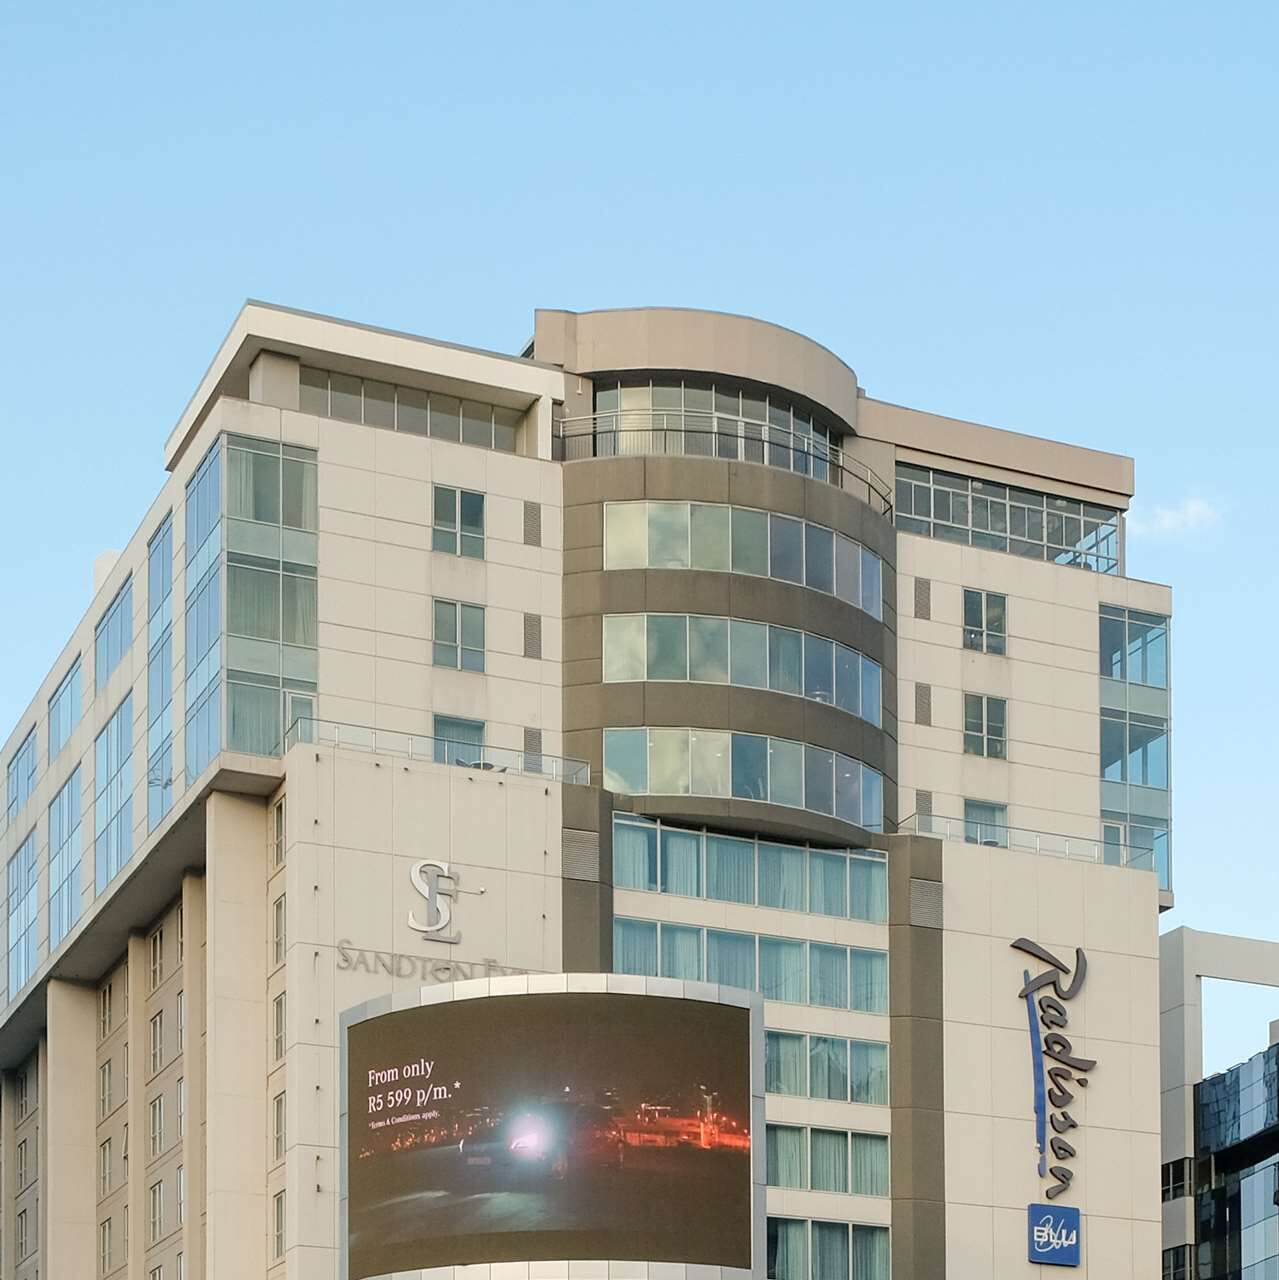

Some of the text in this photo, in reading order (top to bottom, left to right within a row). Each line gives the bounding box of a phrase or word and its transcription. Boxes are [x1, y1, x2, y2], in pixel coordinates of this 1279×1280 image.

[368, 1058, 434, 1087] From only
[1010, 937, 1097, 1200] Radisson
[368, 1095, 383, 1113] R5
[387, 1088, 412, 1107] 599
